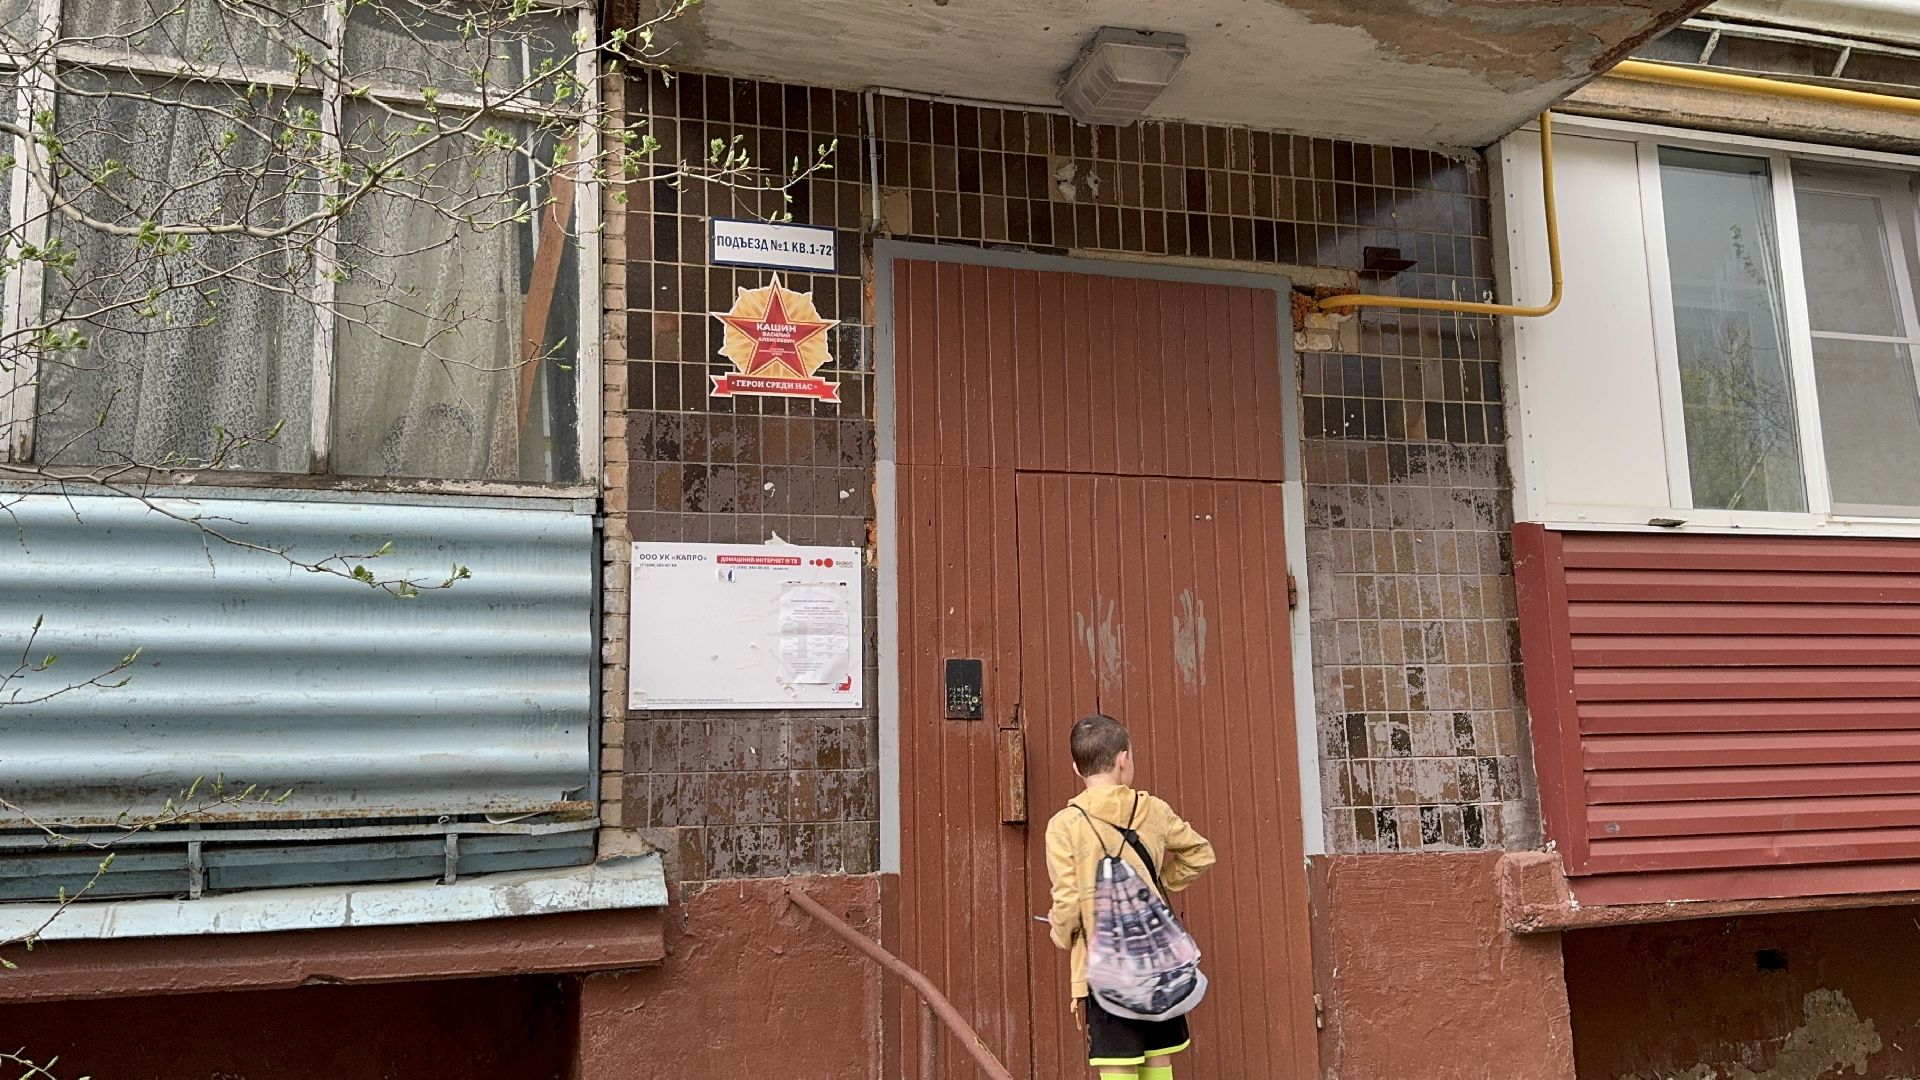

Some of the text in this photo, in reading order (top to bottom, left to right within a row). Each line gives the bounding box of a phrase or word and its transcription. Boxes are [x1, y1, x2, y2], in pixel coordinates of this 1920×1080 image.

[717, 235, 832, 256] ПОДЪЕЗД №1 КВ.1-72
[756, 322, 796, 332] КАШИН
[766, 381, 794, 389] СРЕДИ
[795, 382, 812, 390] НАС
